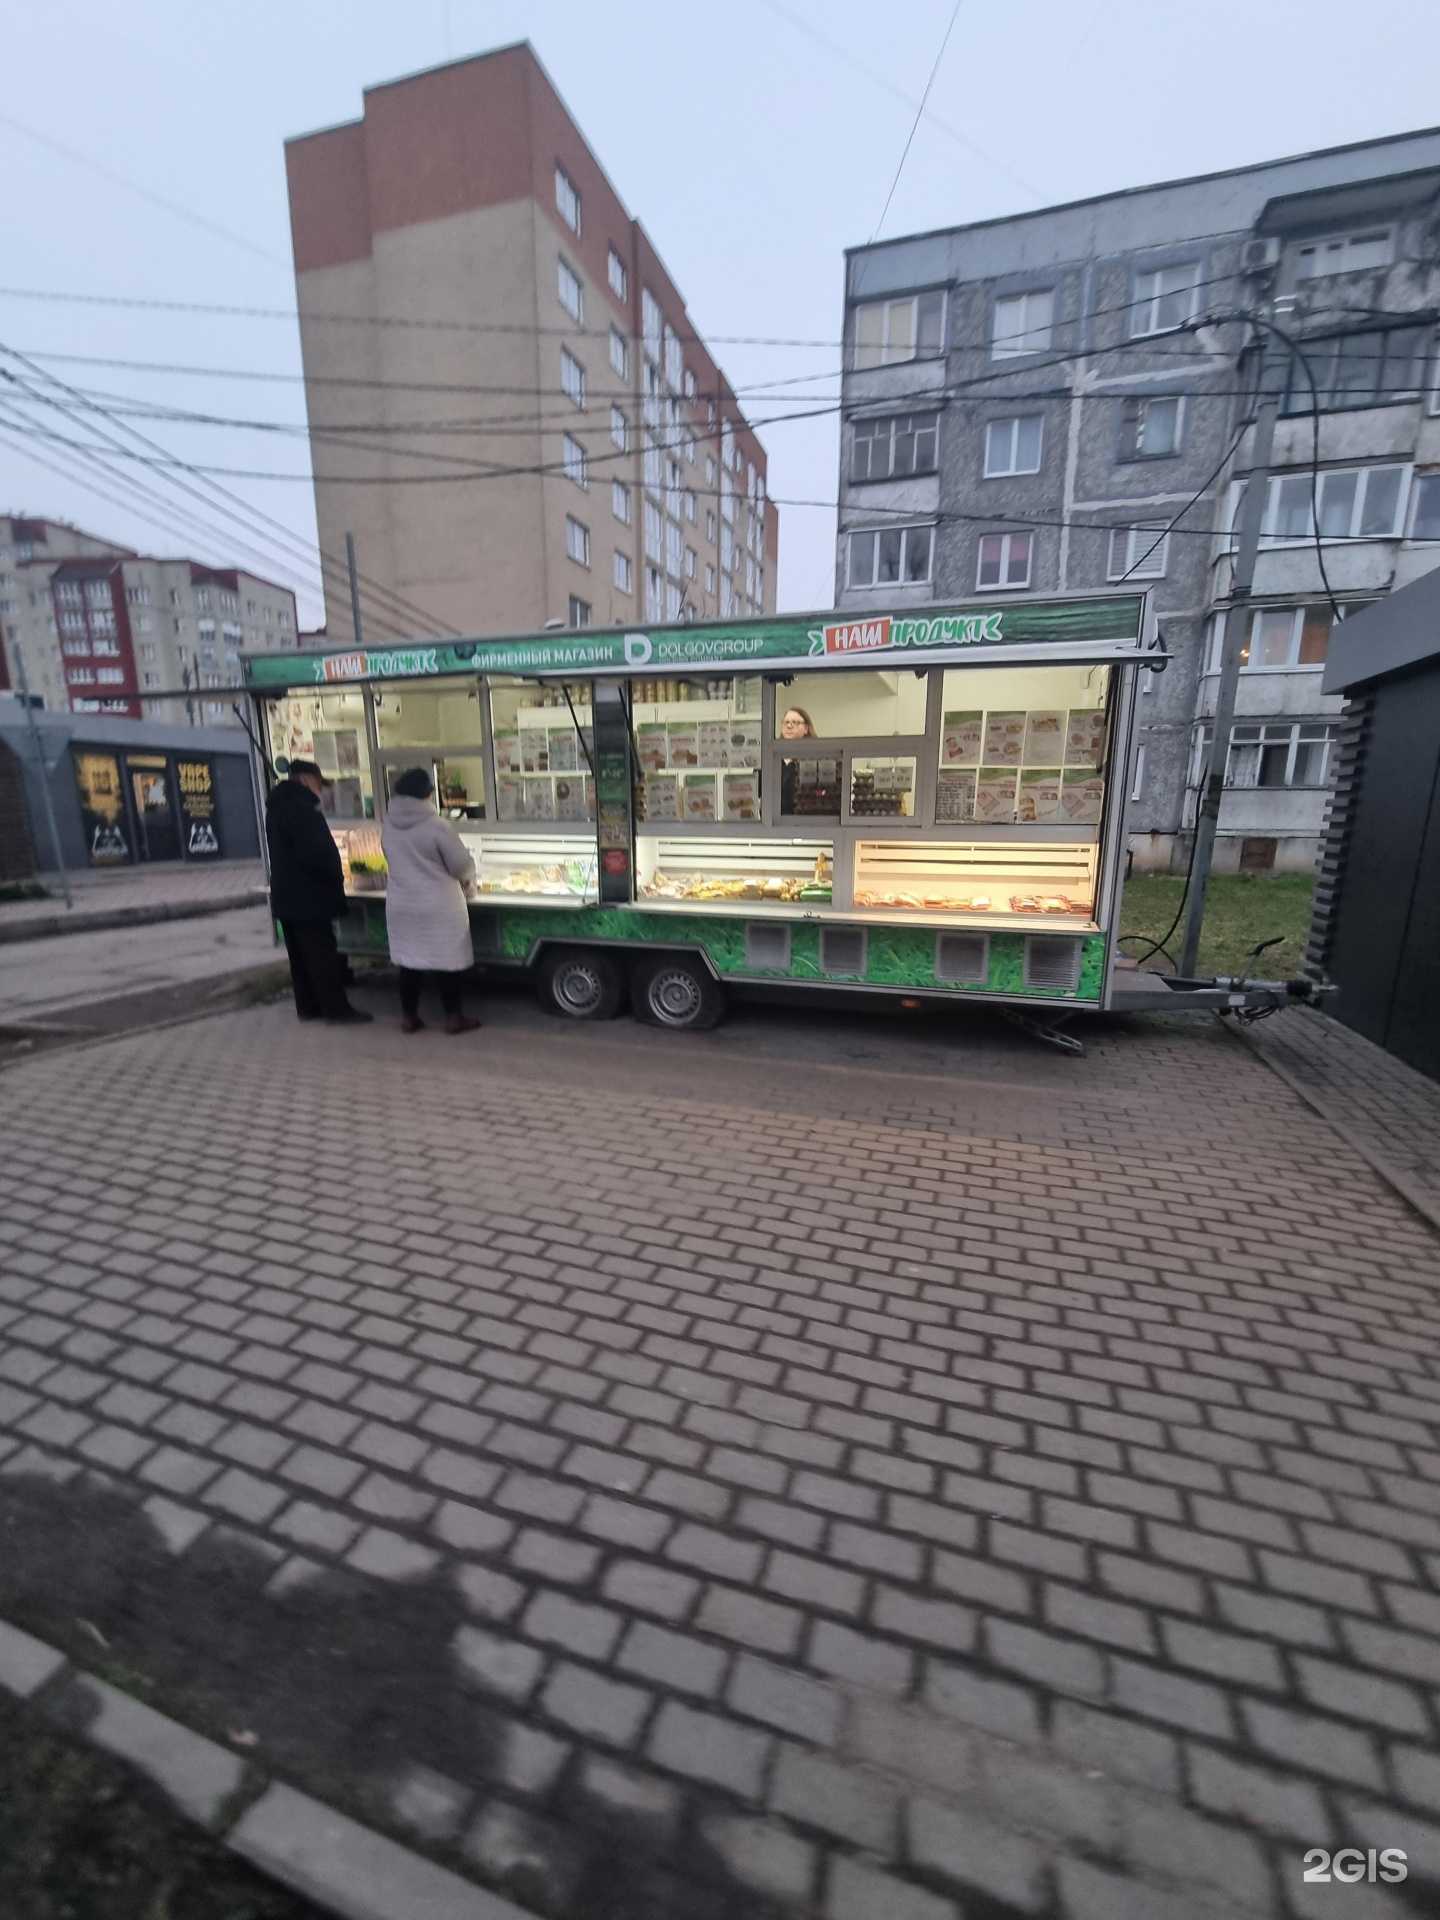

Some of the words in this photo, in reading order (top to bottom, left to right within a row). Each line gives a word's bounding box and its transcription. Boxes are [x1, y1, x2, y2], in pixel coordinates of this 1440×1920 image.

[834, 622, 883, 649] НАШ
[889, 616, 985, 646] ПРОДУКТ
[471, 648, 551, 668] ФИРМЕННЫЙ
[554, 646, 613, 663] МАГАЗИН
[658, 638, 764, 658] DOLGOVGROUP
[331, 655, 362, 677] НАШ
[180, 777, 212, 793] SHOP
